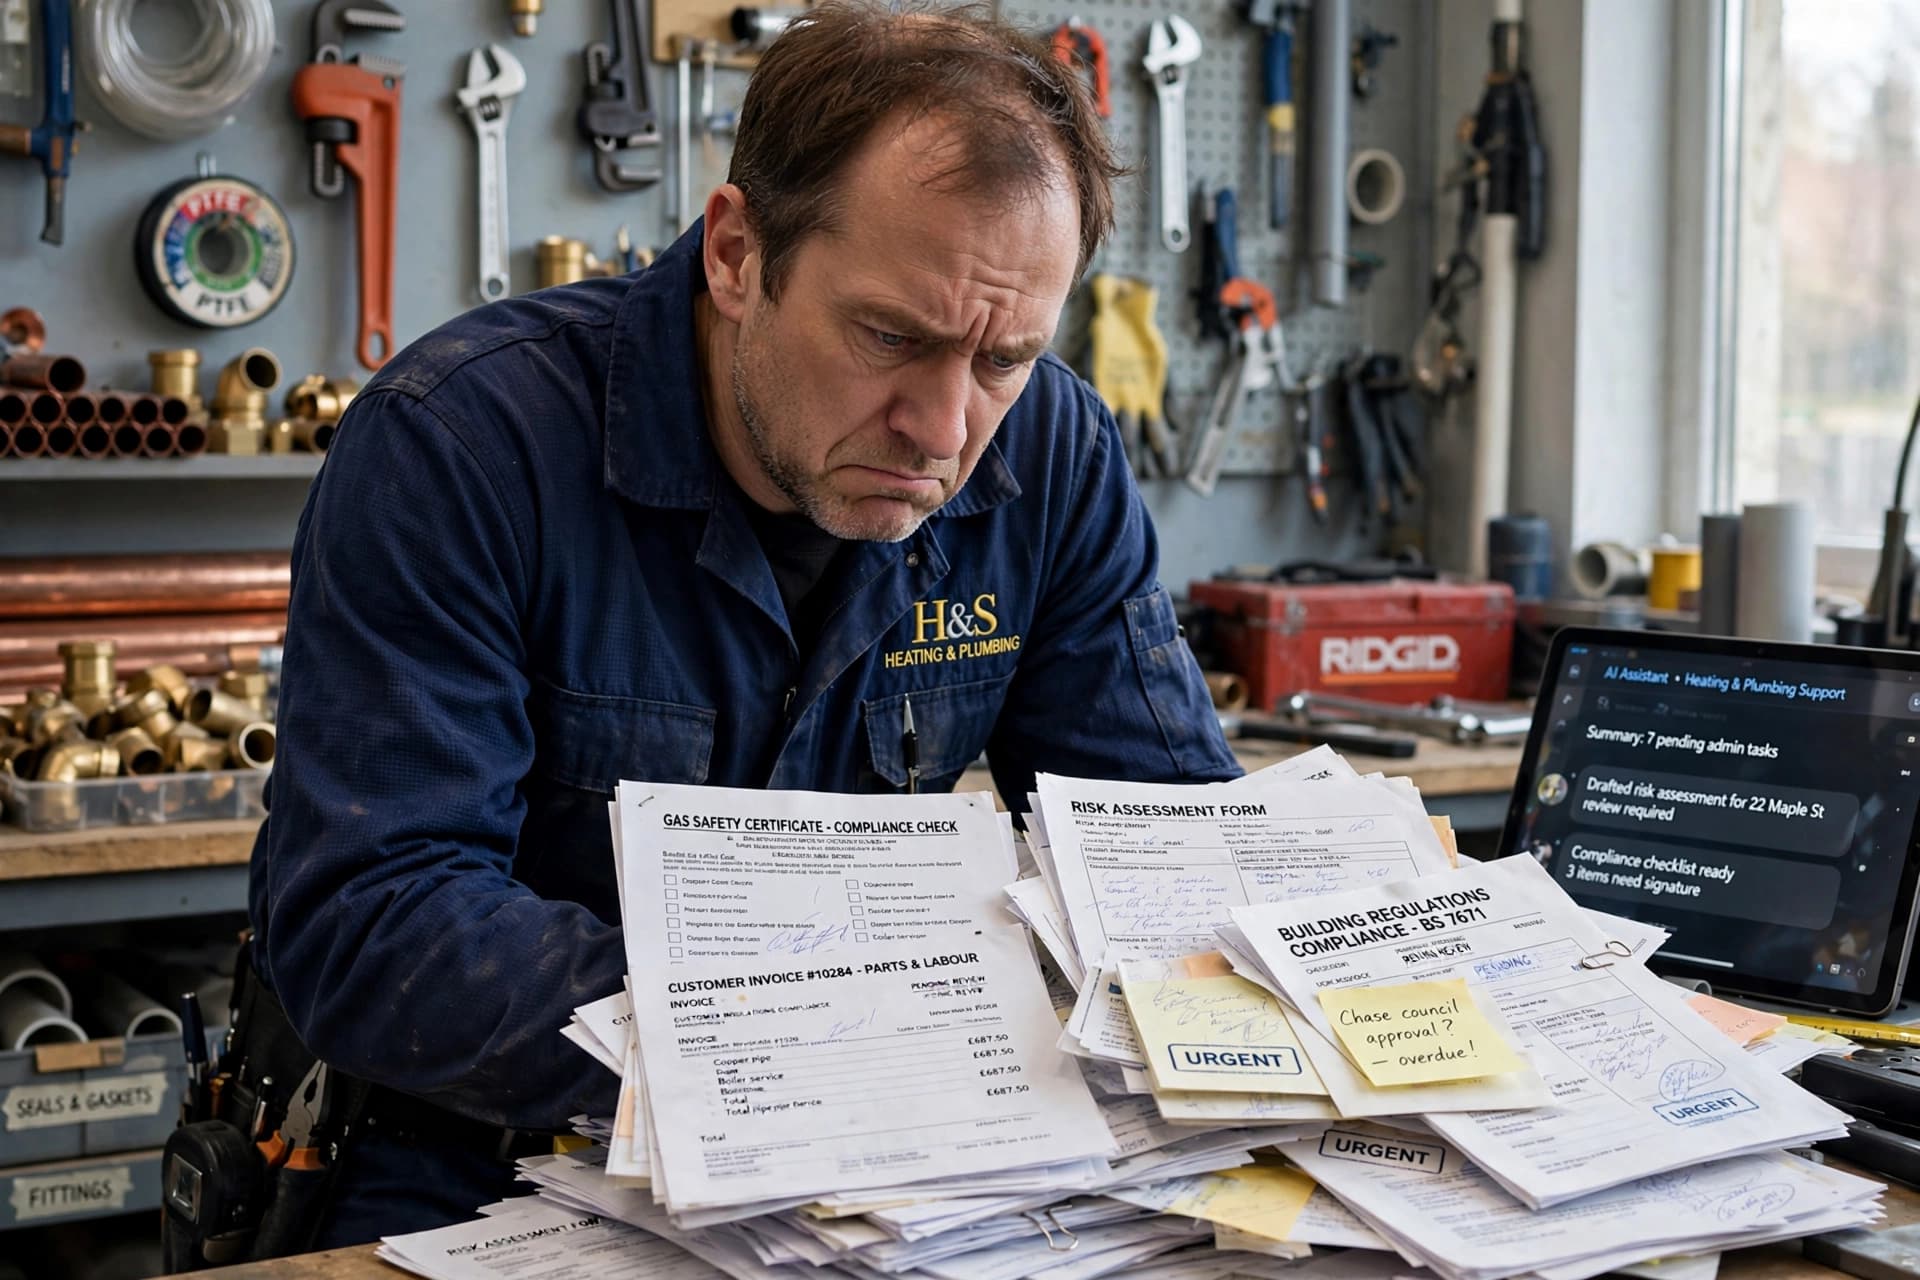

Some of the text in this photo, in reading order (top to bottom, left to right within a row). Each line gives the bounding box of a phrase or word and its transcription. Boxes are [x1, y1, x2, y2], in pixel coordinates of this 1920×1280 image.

[911, 593, 999, 644] H&S
[885, 635, 1021, 669] HEATING & PLUMBING
[1320, 634, 1460, 674] RIDGID
[1604, 666, 1847, 702] AI Assistant Heating & Plumbing Support
[1586, 724, 1779, 759] Summary: 7 pending admin tasks
[1071, 801, 1267, 818] RISK ASSESSMENT FORM
[1582, 798, 1676, 822] review required
[1587, 776, 1825, 819] Drafted risk assessment for 22 Maple St
[663, 813, 690, 828] GAS
[693, 815, 741, 830] SAFETY
[744, 818, 824, 833] CERTIFICATE
[834, 820, 915, 833] COMPLIANCE
[917, 820, 959, 833] CHECK
[1570, 845, 1736, 884] Compliance checklist ready
[1565, 864, 1701, 897] 3 items need signature
[1277, 887, 1490, 942] BUILDING REGULATIONS
[1289, 923, 1410, 958] COMPLIANCE
[1419, 916, 1446, 932] BS
[1444, 906, 1488, 926] 7671
[668, 977, 746, 993] CUSTOMER
[749, 971, 805, 987] INVOICE
[807, 966, 853, 980] #10284
[864, 960, 908, 974] PARTS
[911, 959, 921, 969] &
[923, 952, 980, 968] LABOUR
[670, 997, 716, 1009] INVOICE
[1340, 998, 1460, 1026] Chase council
[713, 1033, 1009, 1066] Copper pipe £687.50
[973, 1047, 1014, 1059] £687.50
[1184, 1051, 1283, 1068] URGENT
[1399, 1039, 1478, 1066] overdue!
[718, 1065, 1022, 1086] Boiler service £687.50
[16, 1086, 153, 1119] SEALS & GASKETS
[722, 1084, 1030, 1105] Total £687.50
[1669, 1097, 1739, 1120] URGENT
[726, 1105, 750, 1116] Total
[700, 1133, 726, 1144] Total
[1334, 1138, 1430, 1165] URGENT
[29, 1178, 113, 1209] FITTINGS
